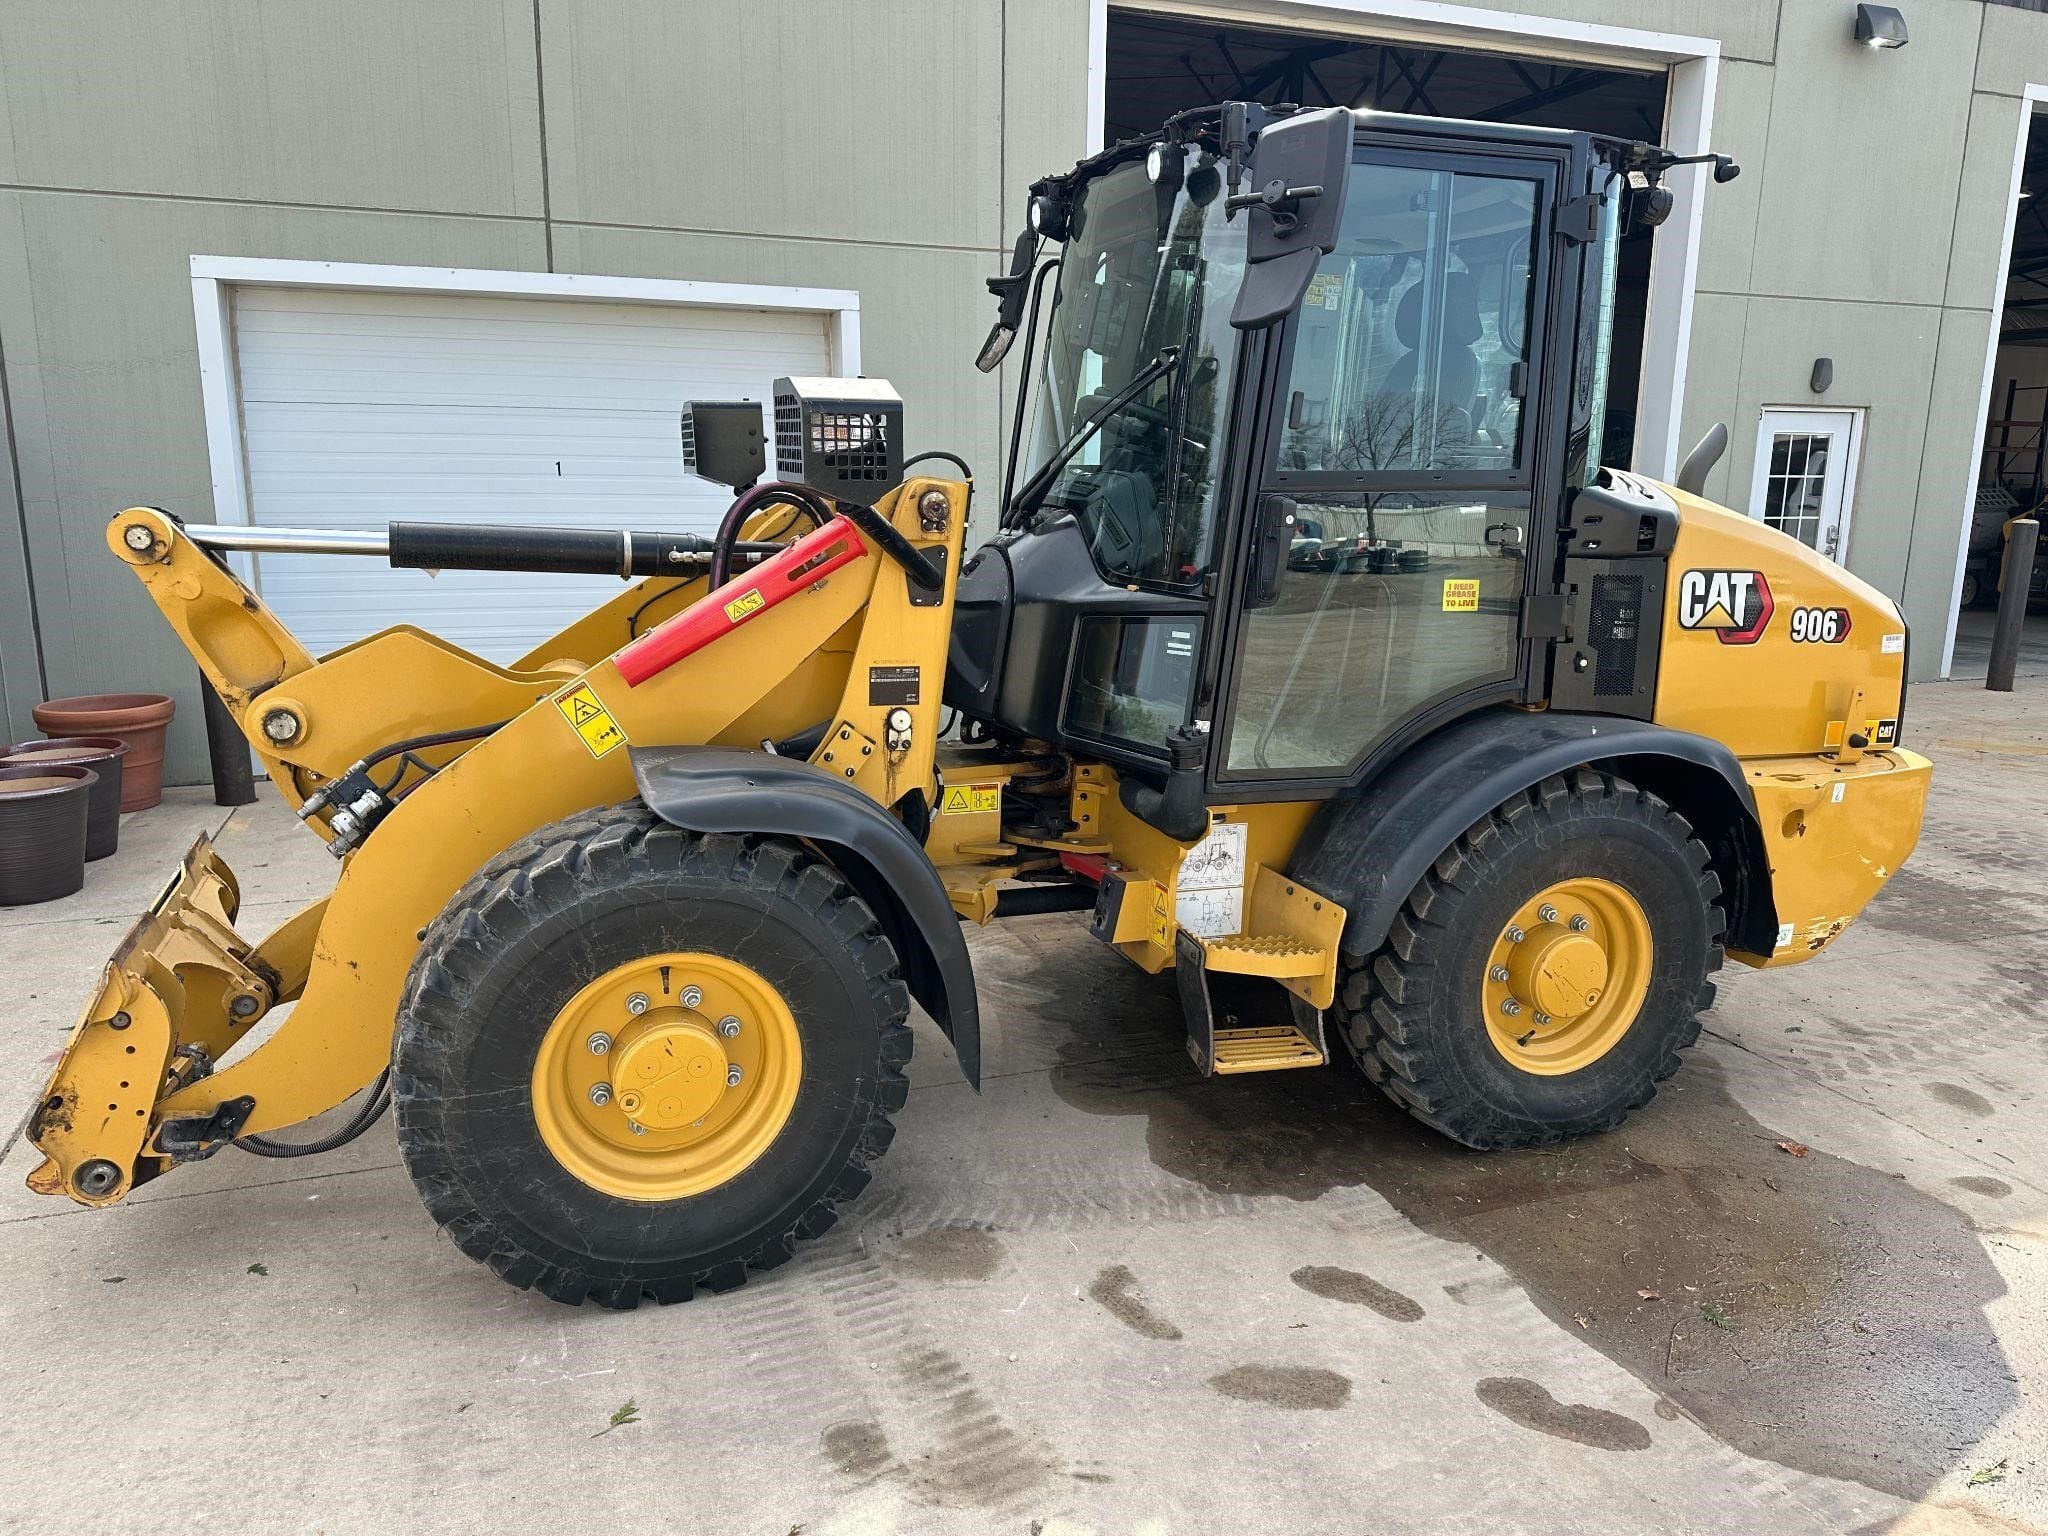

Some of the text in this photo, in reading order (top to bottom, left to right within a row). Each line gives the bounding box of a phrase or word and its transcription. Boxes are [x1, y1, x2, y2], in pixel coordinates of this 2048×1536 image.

[555, 461, 561, 476] 1
[1454, 583, 1475, 591] NEED
[1680, 571, 1754, 628] CAT
[1791, 609, 1838, 642] 906
[1879, 725, 1894, 738] CAT
